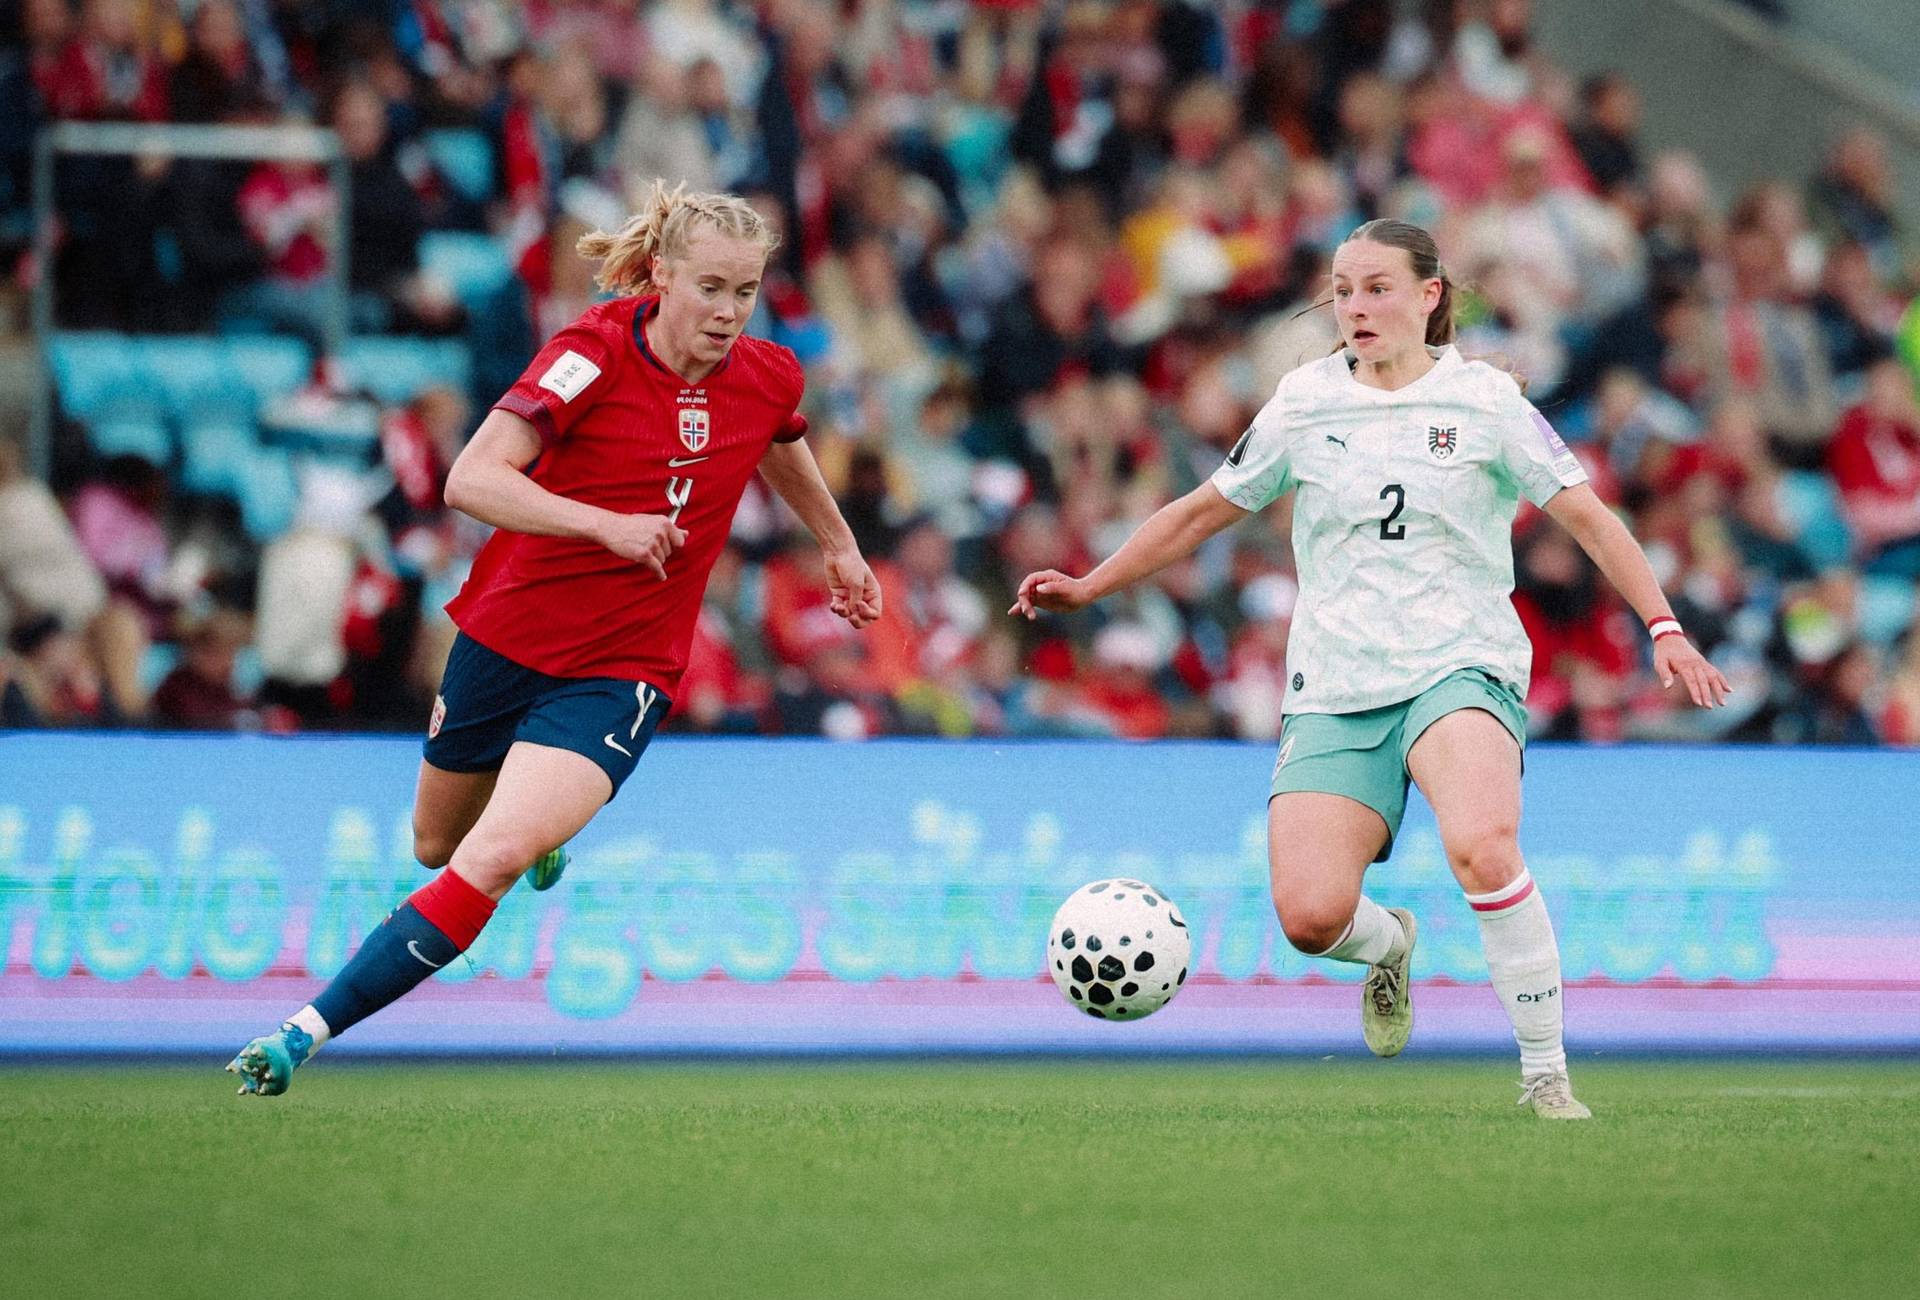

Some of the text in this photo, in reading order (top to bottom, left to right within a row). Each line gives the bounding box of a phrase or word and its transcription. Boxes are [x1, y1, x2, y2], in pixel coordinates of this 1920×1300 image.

[665, 476, 694, 526] 4
[1379, 484, 1406, 540] 2
[630, 681, 657, 740] 4
[1517, 986, 1557, 1002] ÖFB
